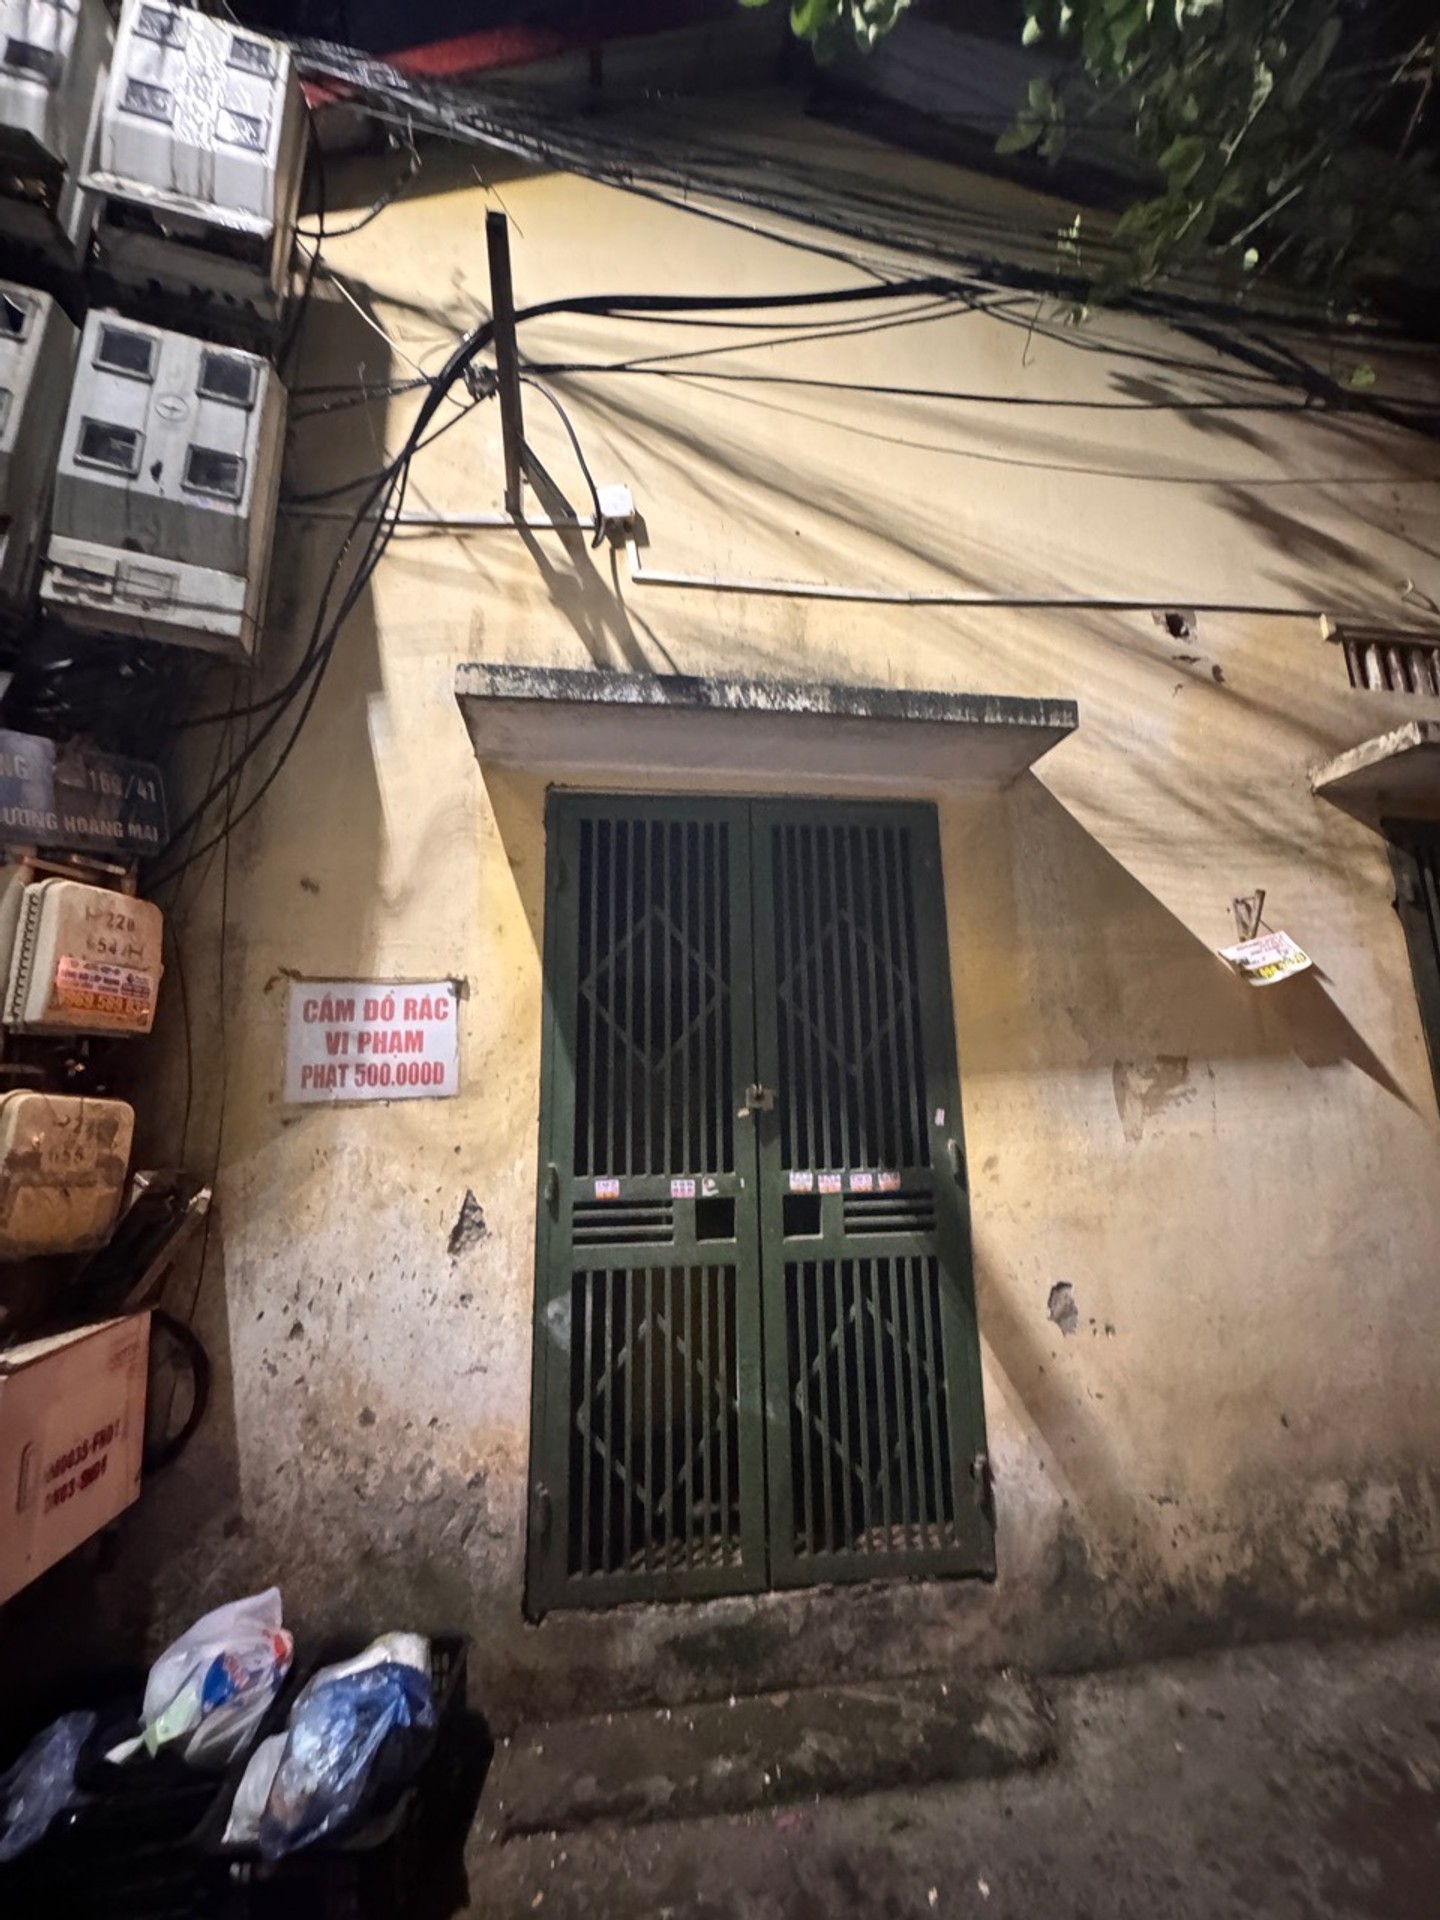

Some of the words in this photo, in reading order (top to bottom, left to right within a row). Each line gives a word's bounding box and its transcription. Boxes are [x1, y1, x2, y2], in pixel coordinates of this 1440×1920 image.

[128, 822, 159, 842] MAI
[302, 990, 356, 1023] CẤM
[402, 993, 450, 1020] RÁC
[325, 1032, 349, 1055] VI
[356, 1030, 424, 1058] PHẠM
[301, 1064, 349, 1092] PHẠT
